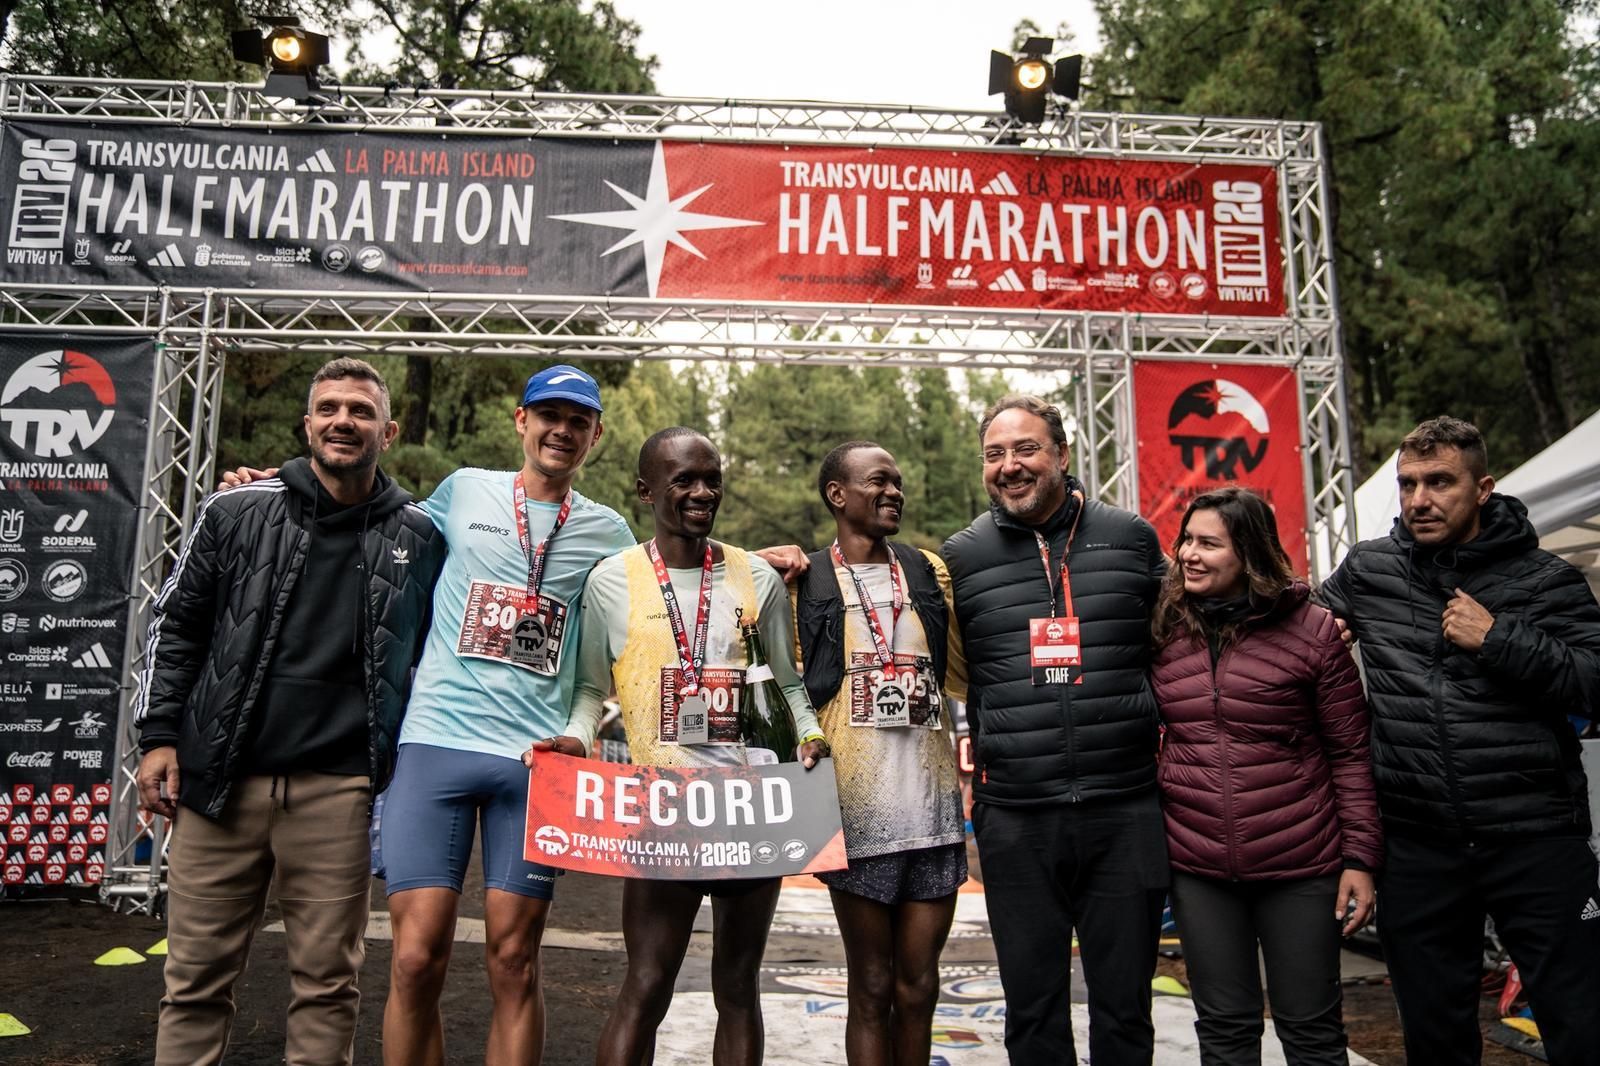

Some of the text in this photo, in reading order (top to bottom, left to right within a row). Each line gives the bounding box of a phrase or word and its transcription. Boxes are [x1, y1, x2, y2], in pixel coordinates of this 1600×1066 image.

[87, 140, 289, 171] TRANSVULCANIA
[345, 149, 535, 178] LA PALMA ISLAND
[780, 161, 975, 194] TRANSVULCANIA
[1027, 173, 1204, 202] LA PALMA ISLAND
[75, 173, 534, 246] HALFMARATHON
[778, 193, 1206, 270] HALFMARATHON
[8, 249, 46, 264] PALMA
[50, 250, 63, 265] LA
[211, 252, 245, 260] Gobierno
[256, 254, 295, 263] Canarias
[275, 248, 295, 256] Islas
[221, 259, 251, 267] Canarias
[399, 260, 528, 276] www.transvulcania.com
[1217, 287, 1269, 302] LA PALMA
[0, 408, 115, 458] TRV
[1169, 434, 1269, 481] TRV
[28, 480, 62, 492] PALMA
[69, 480, 108, 492] ISLAND
[468, 522, 511, 537] BROOKS
[42, 536, 96, 546] SODEPAL
[57, 617, 117, 628] nutrinovex
[462, 584, 485, 646] HALFMARATHON
[8, 653, 51, 662] Canarias
[29, 646, 51, 655] Islas
[1045, 667, 1069, 684] STAFF
[663, 667, 675, 735] HALFMARATHON
[877, 701, 906, 716] TRV
[75, 727, 99, 736] CICAR
[63, 750, 103, 760] POWER
[80, 759, 103, 769] ADE
[575, 770, 793, 827] RECORD
[535, 837, 570, 856] TRV
[571, 832, 690, 857] TRANSVULCANIA
[587, 851, 691, 867] HALFMARATHON
[701, 842, 751, 867] 2026
